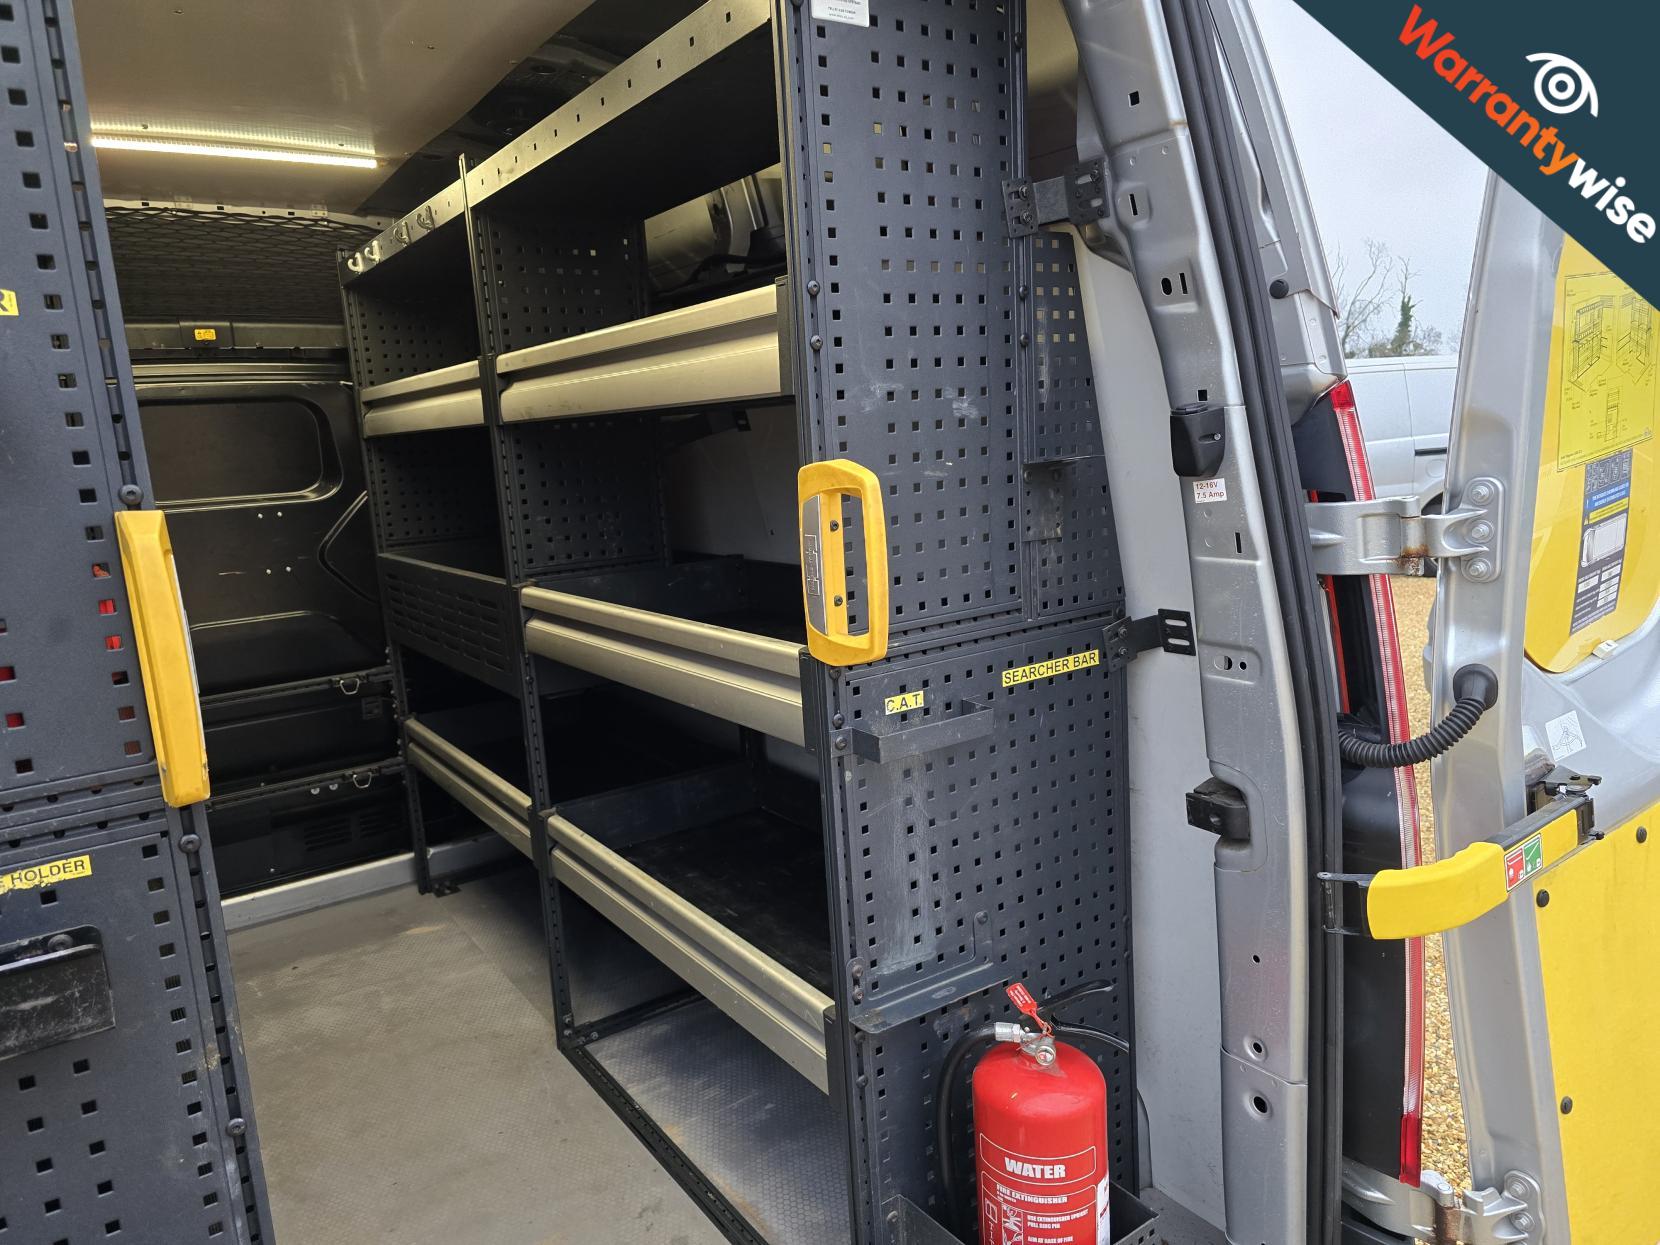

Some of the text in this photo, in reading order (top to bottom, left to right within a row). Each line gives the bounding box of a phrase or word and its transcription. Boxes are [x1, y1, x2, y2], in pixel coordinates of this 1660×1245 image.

[1003, 652, 1098, 685] SEARCHER BAR
[11, 860, 85, 885] HOLDER
[1004, 1157, 1066, 1179] WATER
[996, 1183, 1011, 1197] FIRE
[1012, 1191, 1067, 1204] EXTINGUISHER
